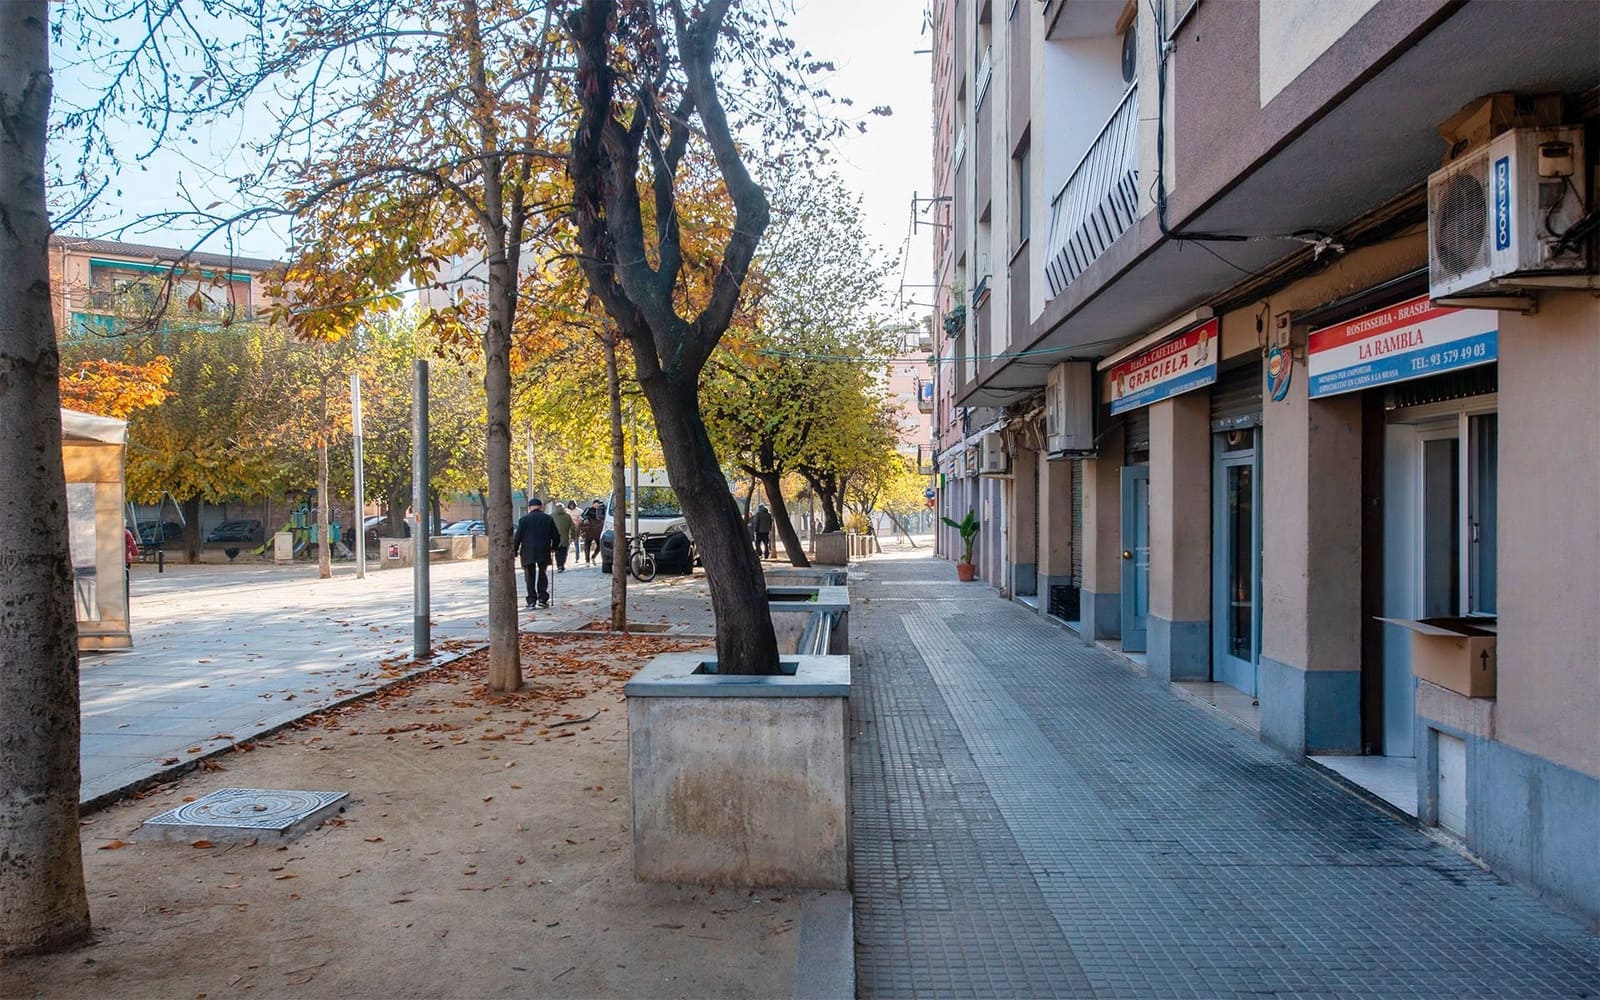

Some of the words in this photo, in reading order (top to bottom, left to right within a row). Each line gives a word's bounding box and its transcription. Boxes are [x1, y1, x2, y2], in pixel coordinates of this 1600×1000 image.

[1499, 164, 1507, 244] DAEWOO
[1346, 312, 1393, 337] ROSTISSERIA
[1359, 343, 1372, 360] LA
[1375, 328, 1424, 356] RAMBLA
[1411, 357, 1429, 370] TEL:
[1430, 353, 1441, 367] 93
[1443, 349, 1459, 364] 579
[1460, 346, 1472, 360] 49
[1473, 342, 1486, 356] 03
[1129, 353, 1188, 391] GRACIELA
